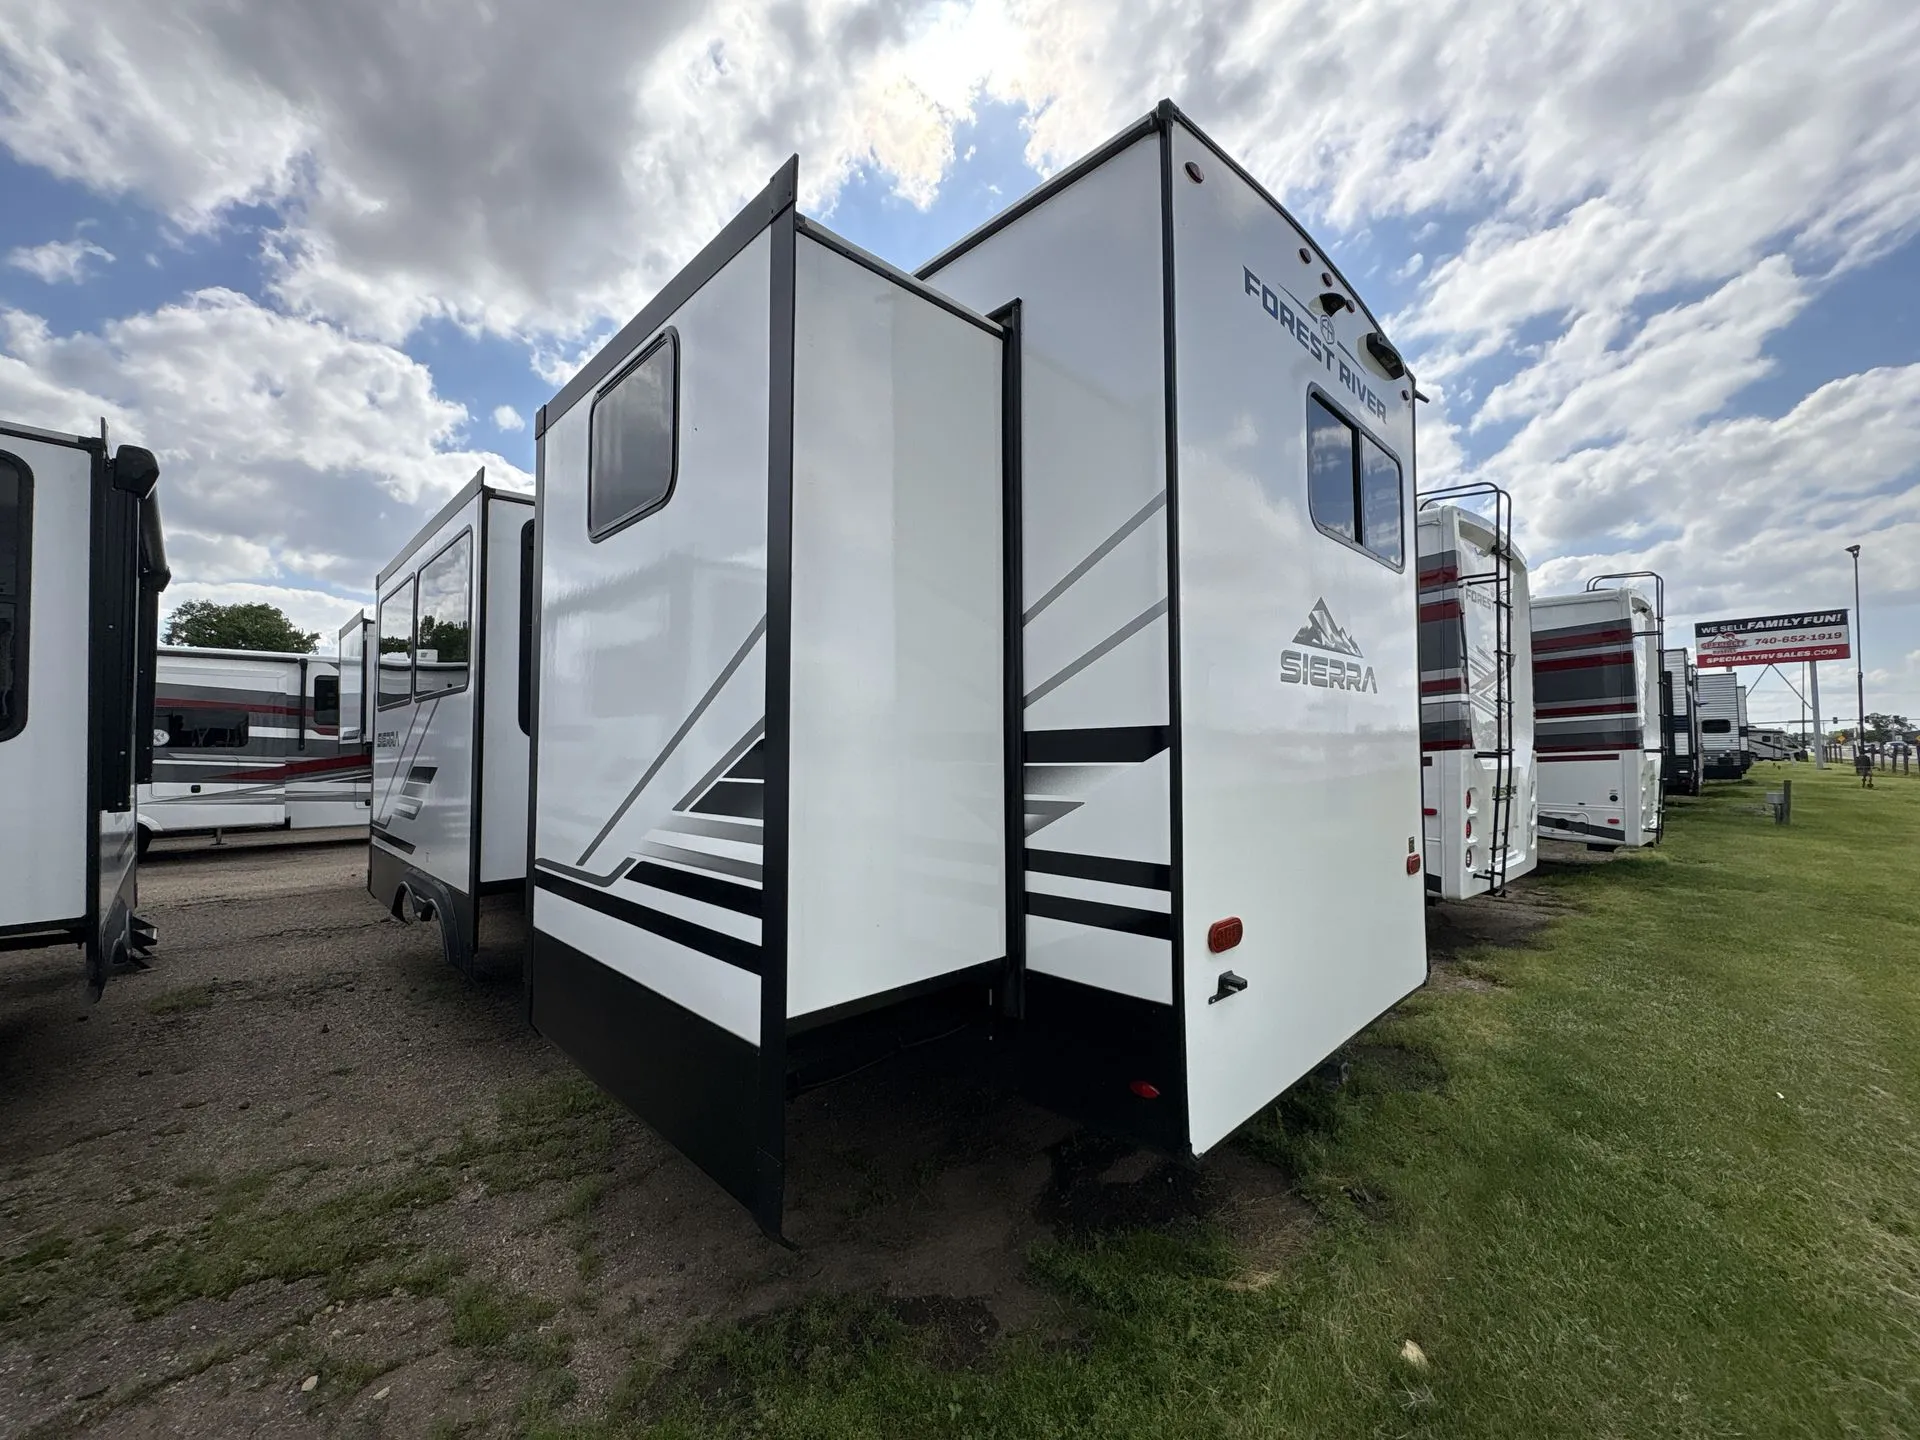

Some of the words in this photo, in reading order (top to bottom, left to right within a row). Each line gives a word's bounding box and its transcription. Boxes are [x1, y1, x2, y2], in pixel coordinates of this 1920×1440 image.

[1242, 264, 1336, 372] FOREST
[1338, 358, 1388, 425] RIVER
[1701, 626, 1718, 634] WE
[1720, 624, 1746, 632] SELL
[1746, 617, 1802, 630] FAMILY
[1802, 613, 1842, 625] FUN!
[1755, 631, 1842, 645] 740-652-1919
[1280, 649, 1378, 694] SIERRA
